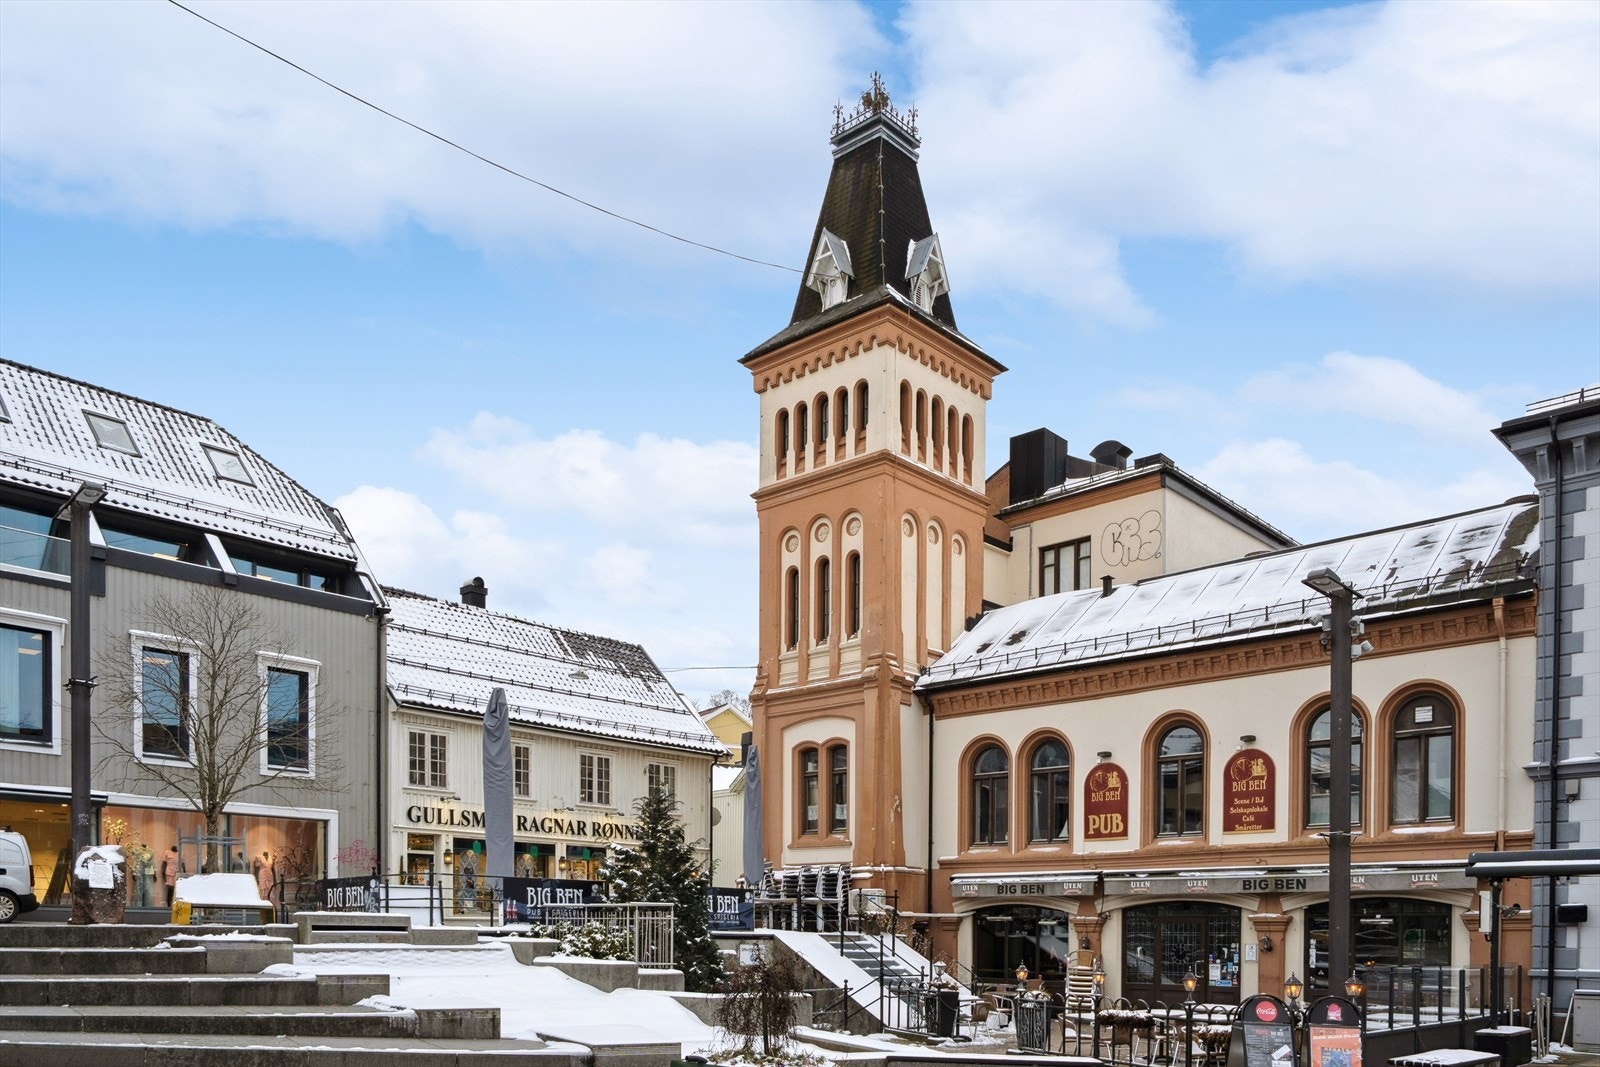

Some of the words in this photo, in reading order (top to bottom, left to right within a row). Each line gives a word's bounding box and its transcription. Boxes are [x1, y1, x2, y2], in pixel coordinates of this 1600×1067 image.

[1232, 782, 1246, 792] BIG
[1249, 780, 1266, 790] BEN
[1092, 792, 1103, 802] BIG
[1105, 790, 1120, 801] BEN
[407, 805, 486, 828] GULLSM
[516, 814, 588, 836] RAGNAR
[592, 821, 643, 841] RØNN
[1088, 813, 1124, 834] PUB
[997, 885, 1017, 895] BIG
[1020, 884, 1045, 894] BEN
[1242, 879, 1269, 890] BIG
[1274, 878, 1307, 890] BEN
[327, 887, 343, 908] BIG
[346, 886, 364, 907] BEN
[526, 887, 551, 908] BIG
[555, 888, 584, 908] BEN
[527, 908, 542, 916] PUB
[717, 896, 739, 914] BEN
